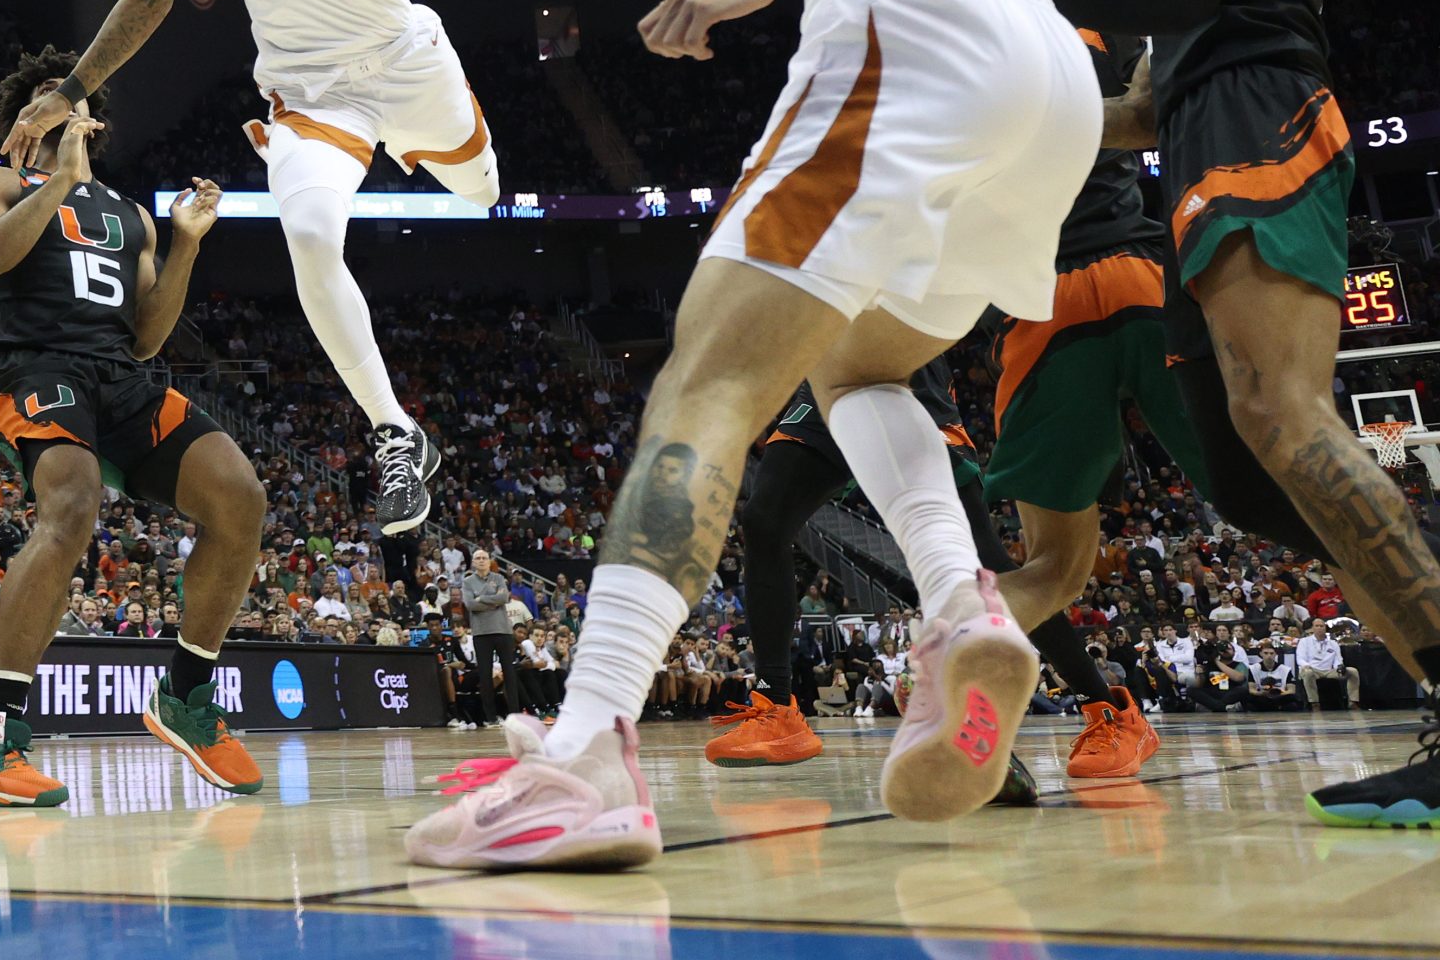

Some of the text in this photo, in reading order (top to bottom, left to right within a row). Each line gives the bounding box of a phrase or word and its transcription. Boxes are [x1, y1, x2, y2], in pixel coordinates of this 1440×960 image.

[1367, 116, 1408, 147] 53
[496, 205, 545, 218] 11 Miller
[651, 204, 666, 217] 15
[70, 250, 124, 308] 15
[1345, 291, 1394, 324] 25
[36, 664, 90, 715] THE
[98, 665, 167, 715] FINA
[374, 669, 408, 689] Great
[277, 688, 304, 704] NCAA
[380, 689, 409, 714] Clips
